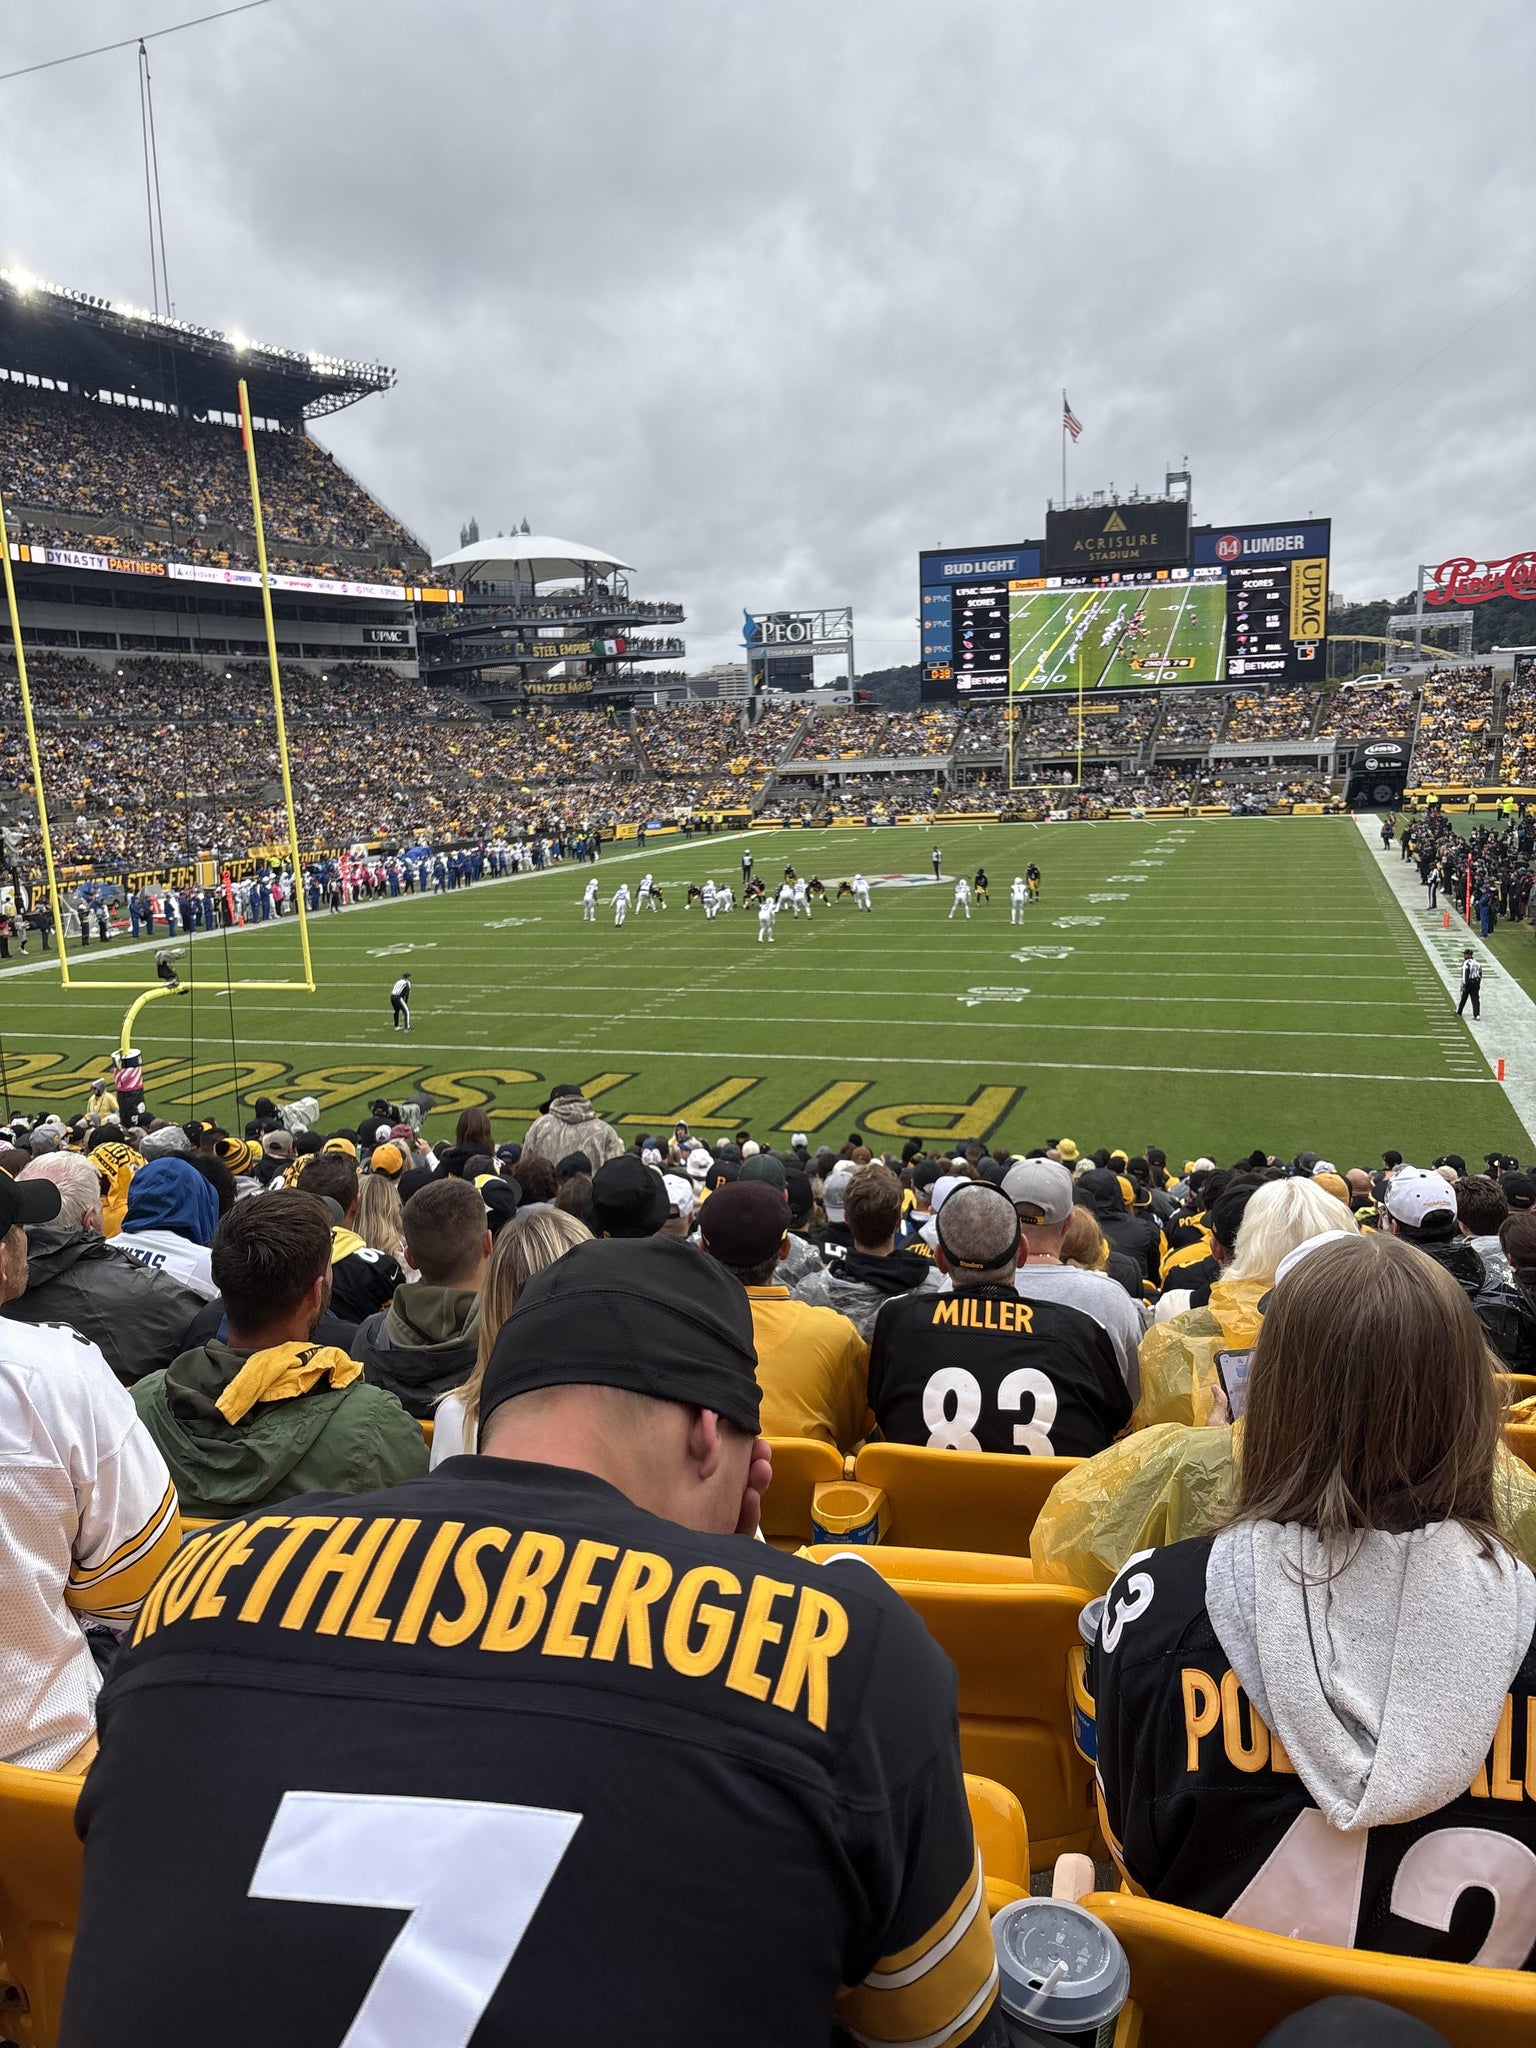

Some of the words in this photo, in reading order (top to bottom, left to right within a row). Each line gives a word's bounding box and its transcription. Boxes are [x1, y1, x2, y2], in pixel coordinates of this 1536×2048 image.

[1073, 533, 1159, 551] ACRISURE
[1218, 540, 1238, 556] 84
[1242, 535, 1305, 554] LUMBER
[47, 552, 104, 568] DYNASTY
[109, 559, 165, 576] PARTNERS
[1088, 550, 1140, 561] STADIUM
[943, 562, 974, 576] BUD
[975, 559, 1016, 574] LIGHT
[1242, 579, 1274, 588] SCORES
[1302, 563, 1322, 635] UPMC
[371, 630, 403, 642] UPMC
[532, 645, 558, 658] STEEL
[931, 1298, 1034, 1334] MILLER
[921, 1366, 1057, 1456] 83
[131, 1516, 850, 1731] ROETHLISBERGER
[247, 1791, 583, 2048] 7
